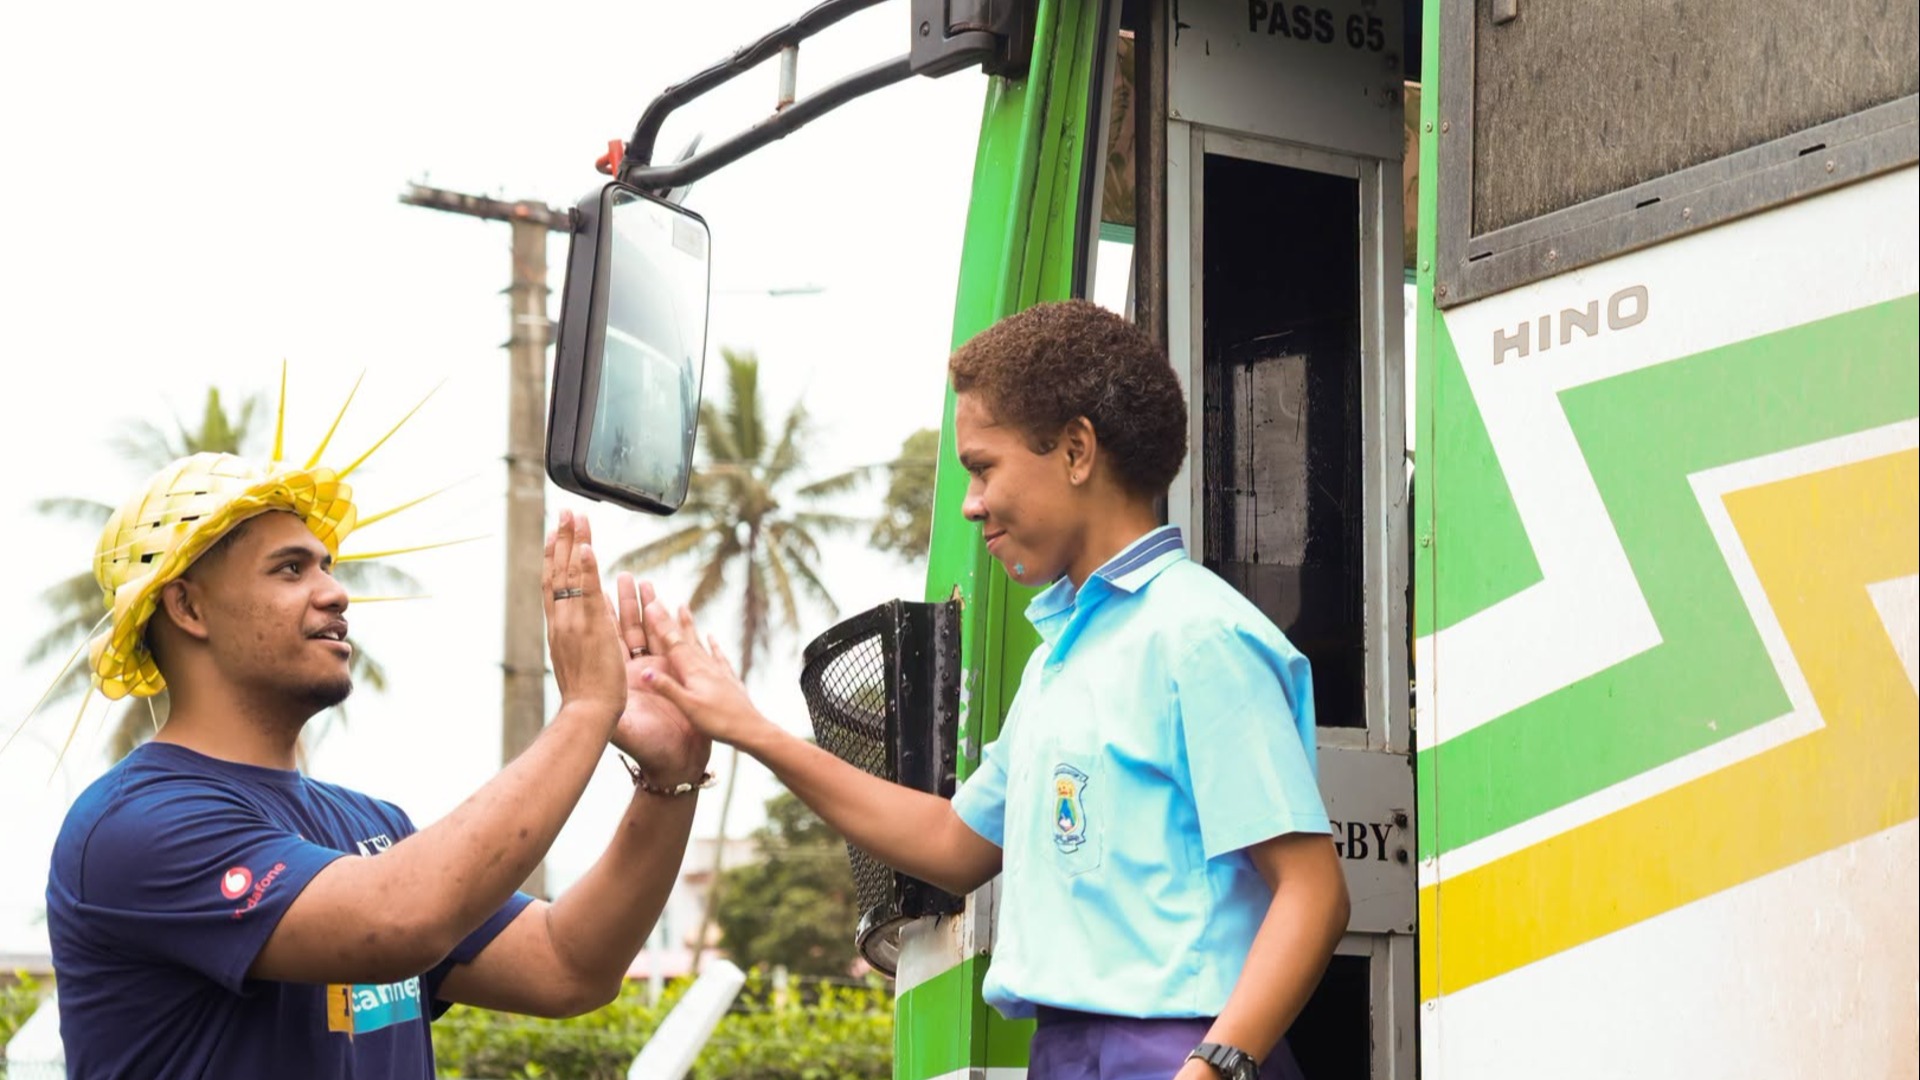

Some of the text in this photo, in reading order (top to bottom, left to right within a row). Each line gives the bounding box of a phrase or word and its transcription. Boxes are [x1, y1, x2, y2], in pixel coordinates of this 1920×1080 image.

[1249, 0, 1385, 51] PASS 65
[1493, 285, 1649, 365] HINO
[232, 863, 286, 919] dafone
